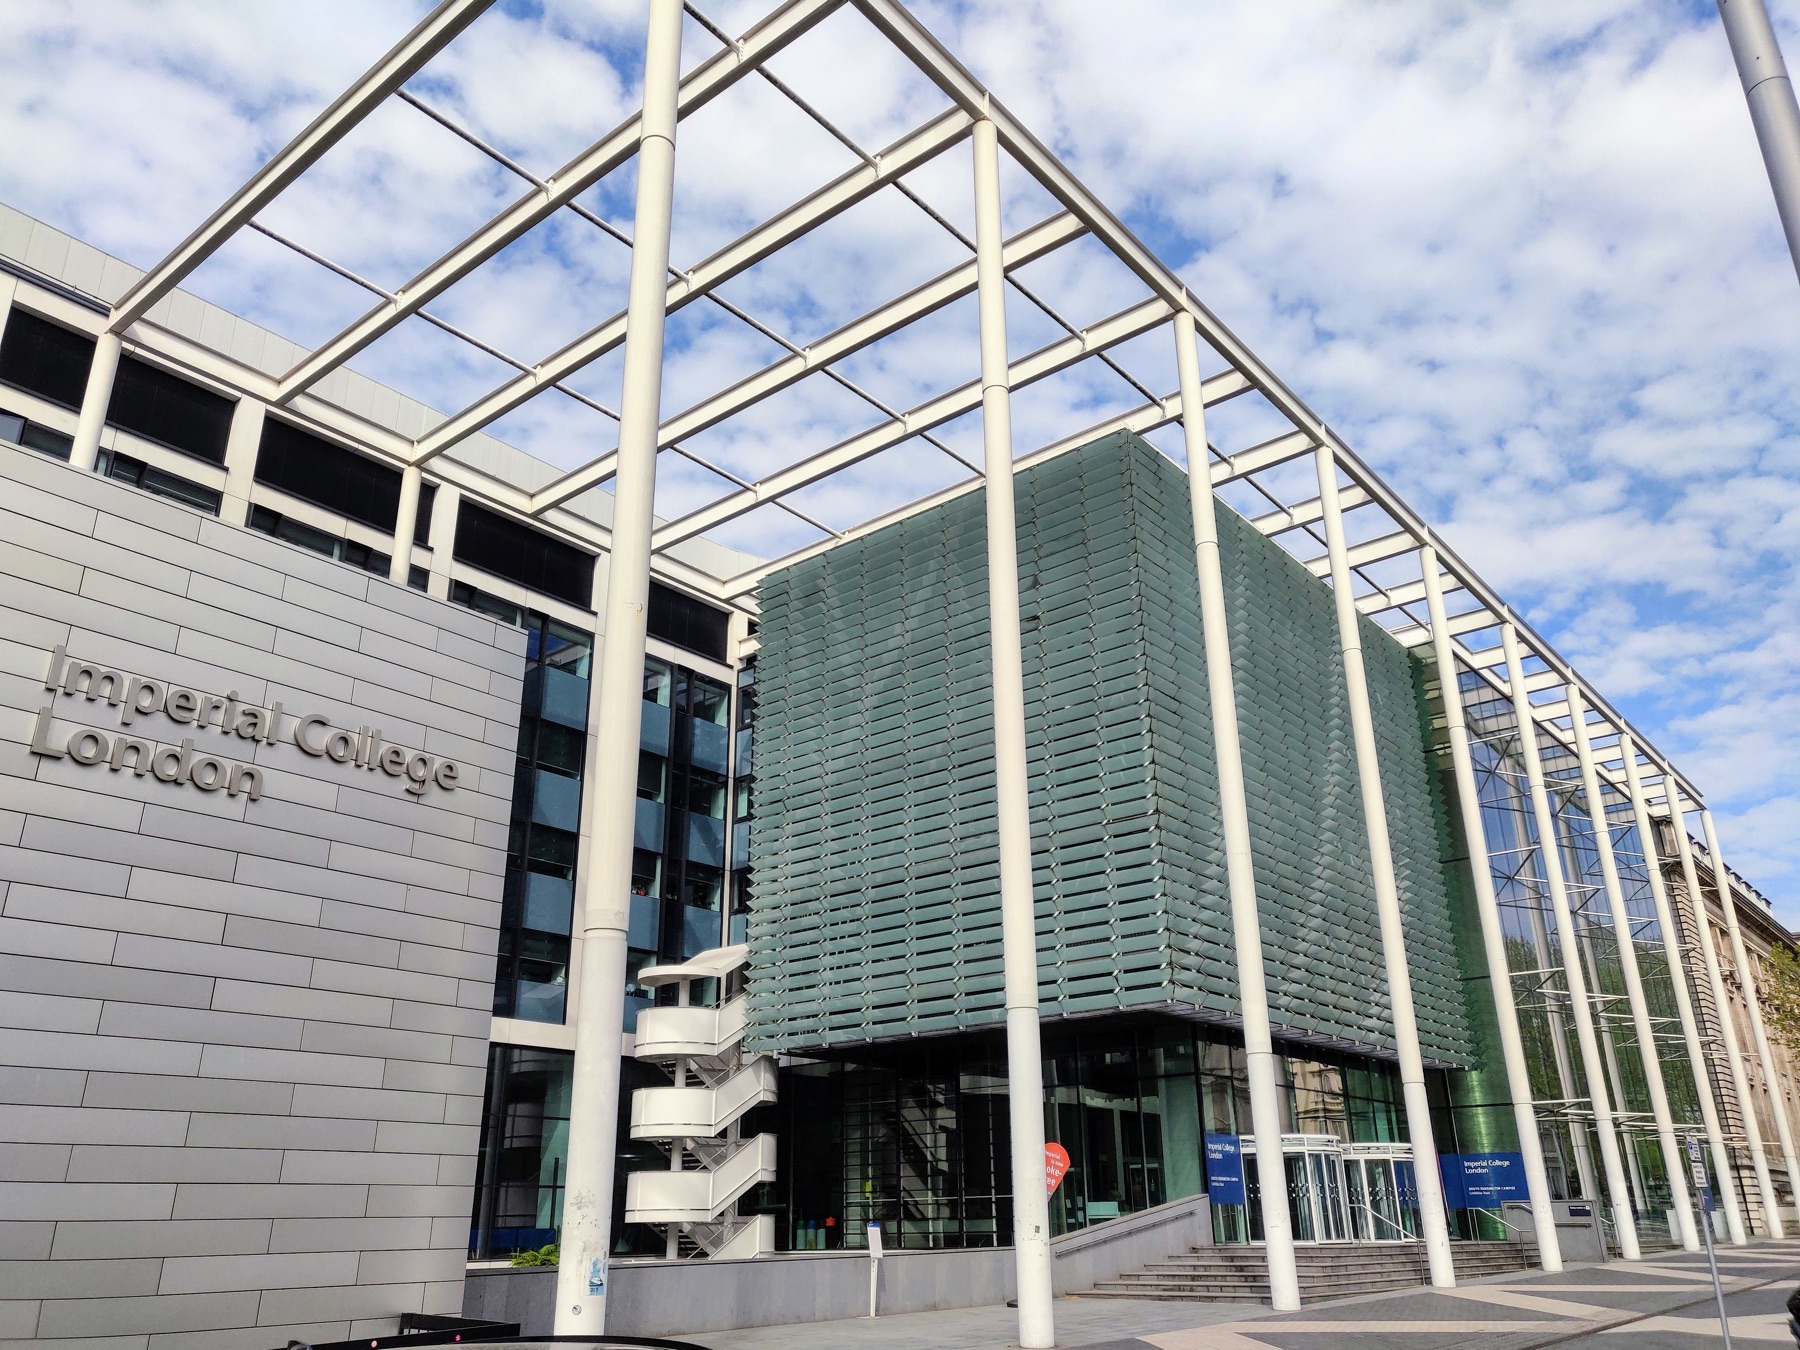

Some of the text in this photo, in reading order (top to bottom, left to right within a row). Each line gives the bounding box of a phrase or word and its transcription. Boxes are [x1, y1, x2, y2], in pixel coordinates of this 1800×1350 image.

[45, 643, 460, 795] Imperial College
[30, 706, 263, 800] London
[1208, 1143, 1222, 1152] Imperial
[1046, 1151, 1061, 1159] mperial
[1209, 1151, 1223, 1159] London
[1464, 1160, 1487, 1168] Imperial
[1047, 1166, 1062, 1176] oke-
